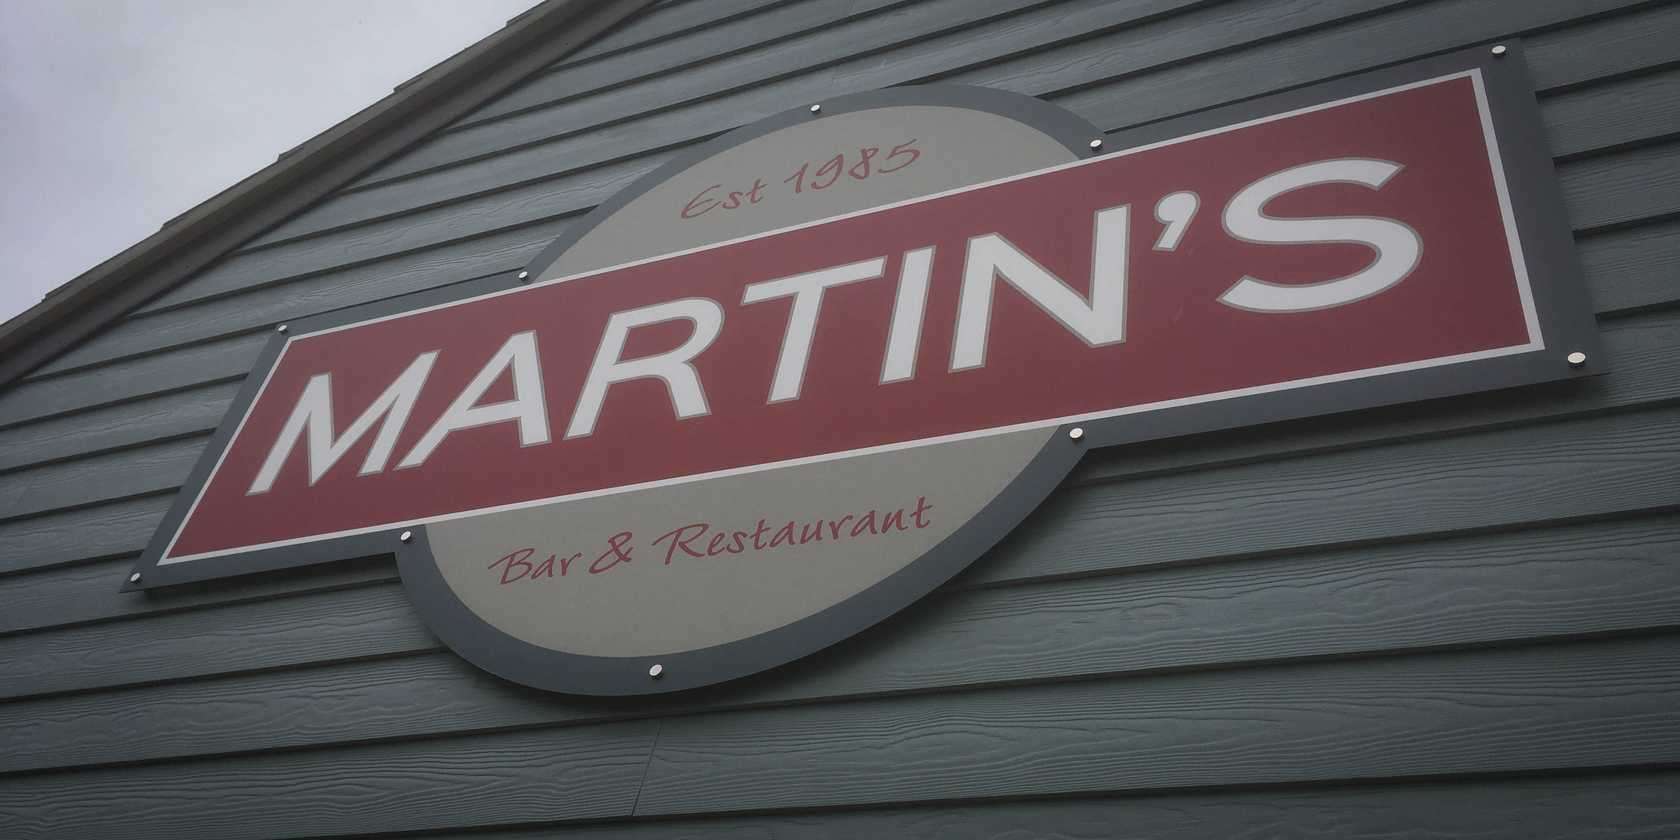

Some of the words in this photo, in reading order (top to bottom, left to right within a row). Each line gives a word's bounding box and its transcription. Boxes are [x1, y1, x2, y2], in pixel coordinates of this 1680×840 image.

[680, 178, 768, 219] Est
[783, 138, 921, 194] 1985
[247, 158, 1424, 496] MARTIN'S
[487, 548, 582, 585] Bar
[588, 531, 633, 575] &
[651, 496, 933, 566] Restaurant
